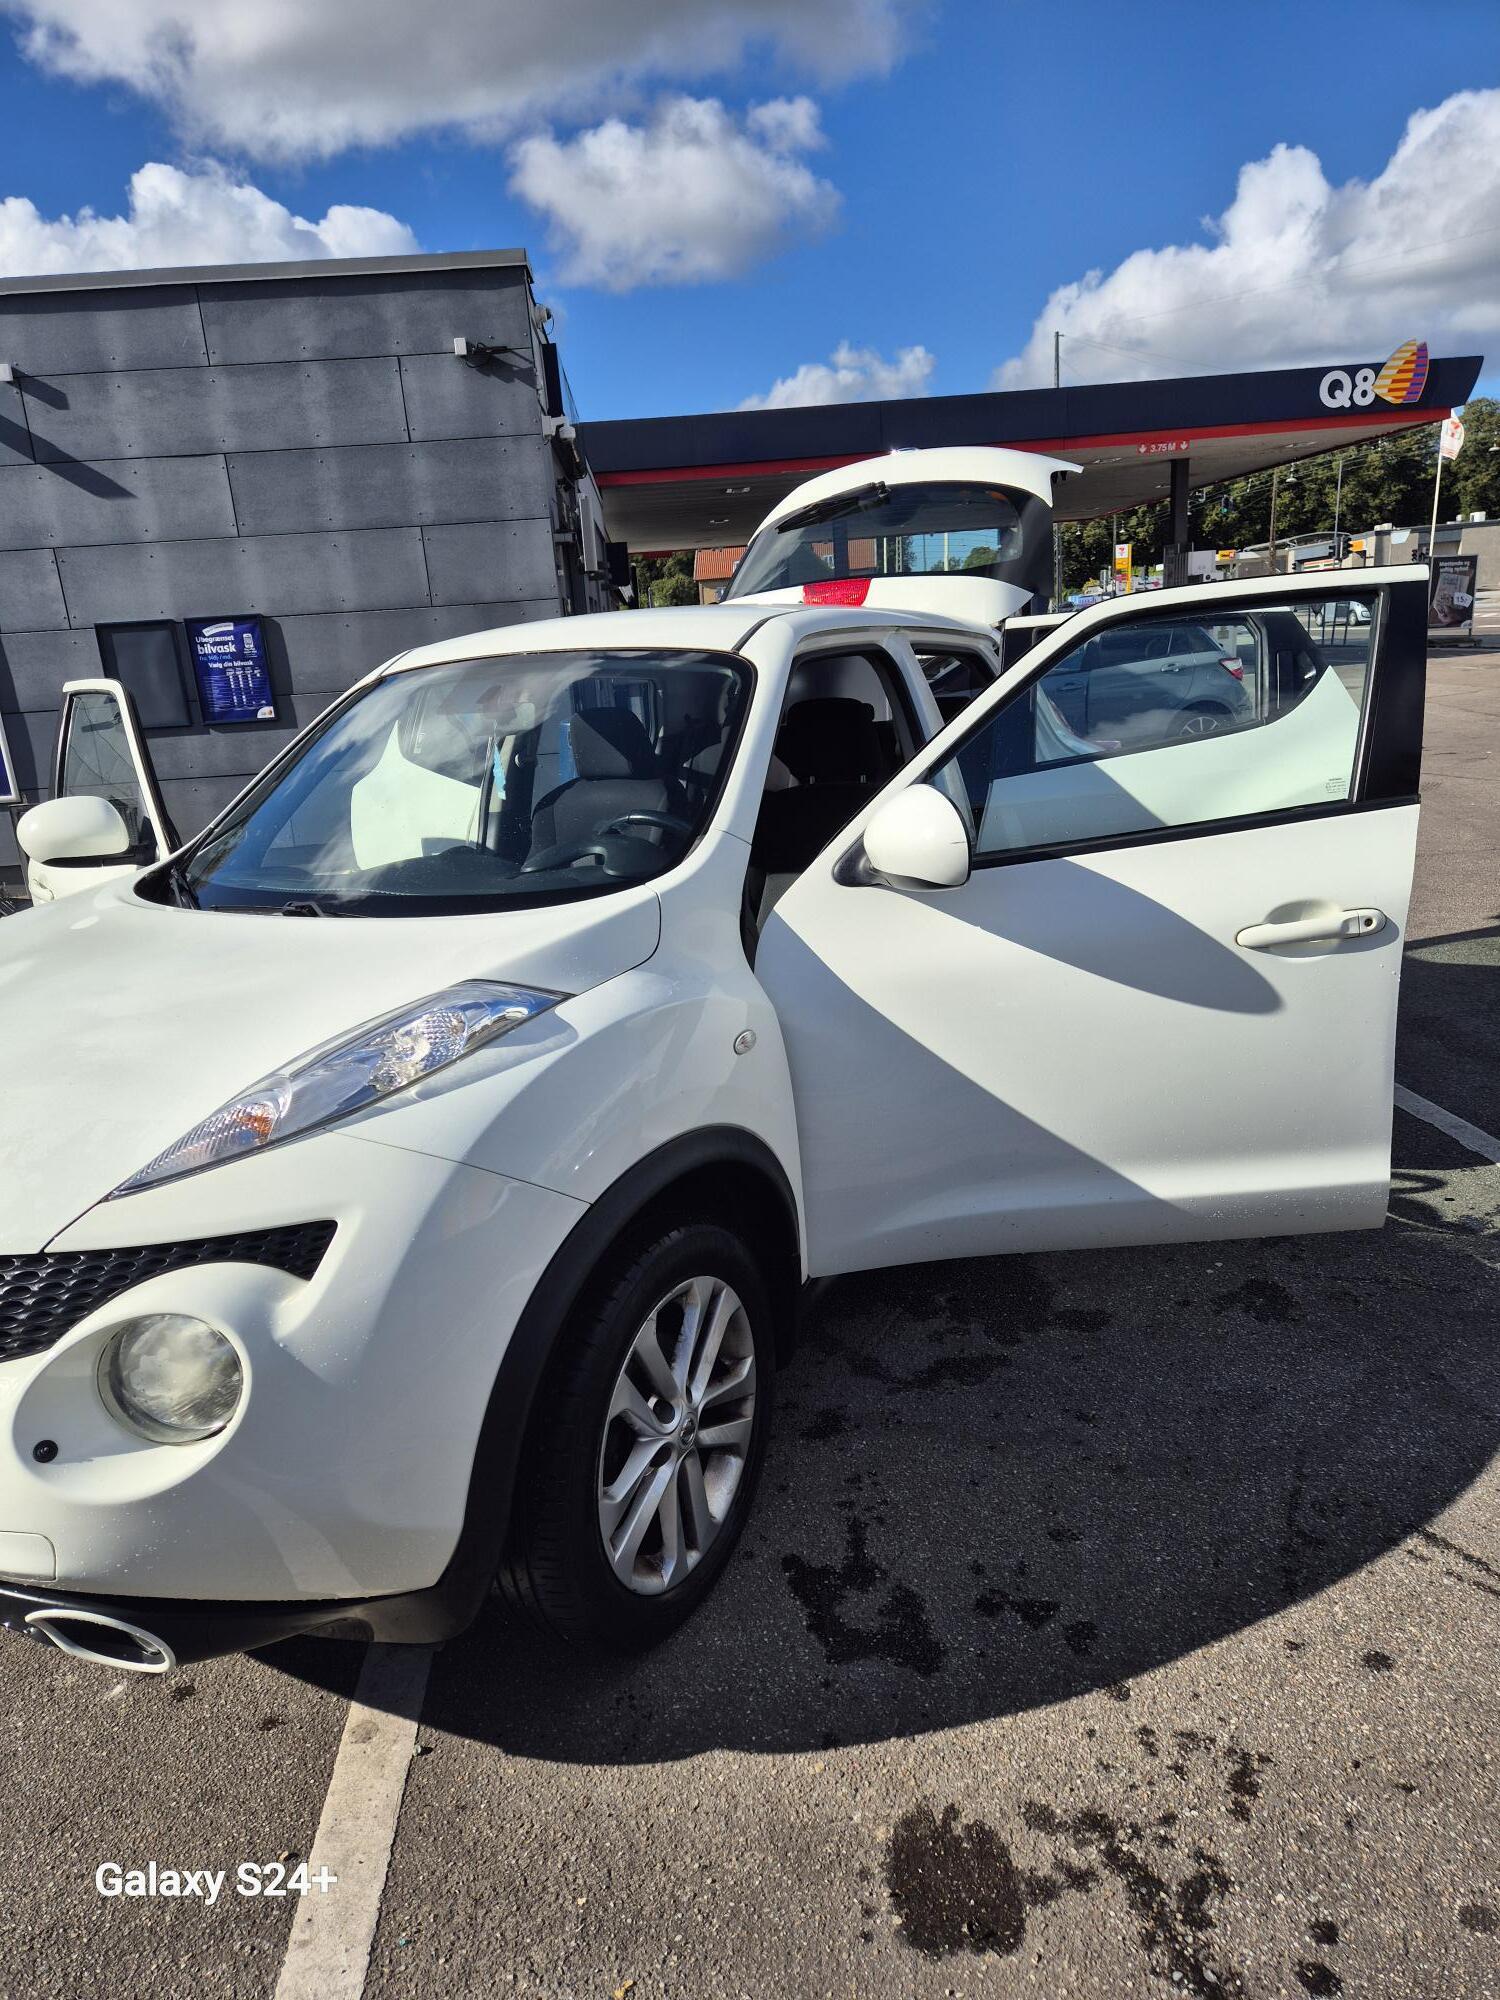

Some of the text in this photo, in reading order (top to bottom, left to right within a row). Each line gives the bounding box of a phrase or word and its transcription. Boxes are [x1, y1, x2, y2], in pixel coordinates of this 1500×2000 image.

[1319, 368, 1376, 408] Q8
[195, 635, 234, 643] Ubegrænset
[197, 642, 236, 654] bilvask
